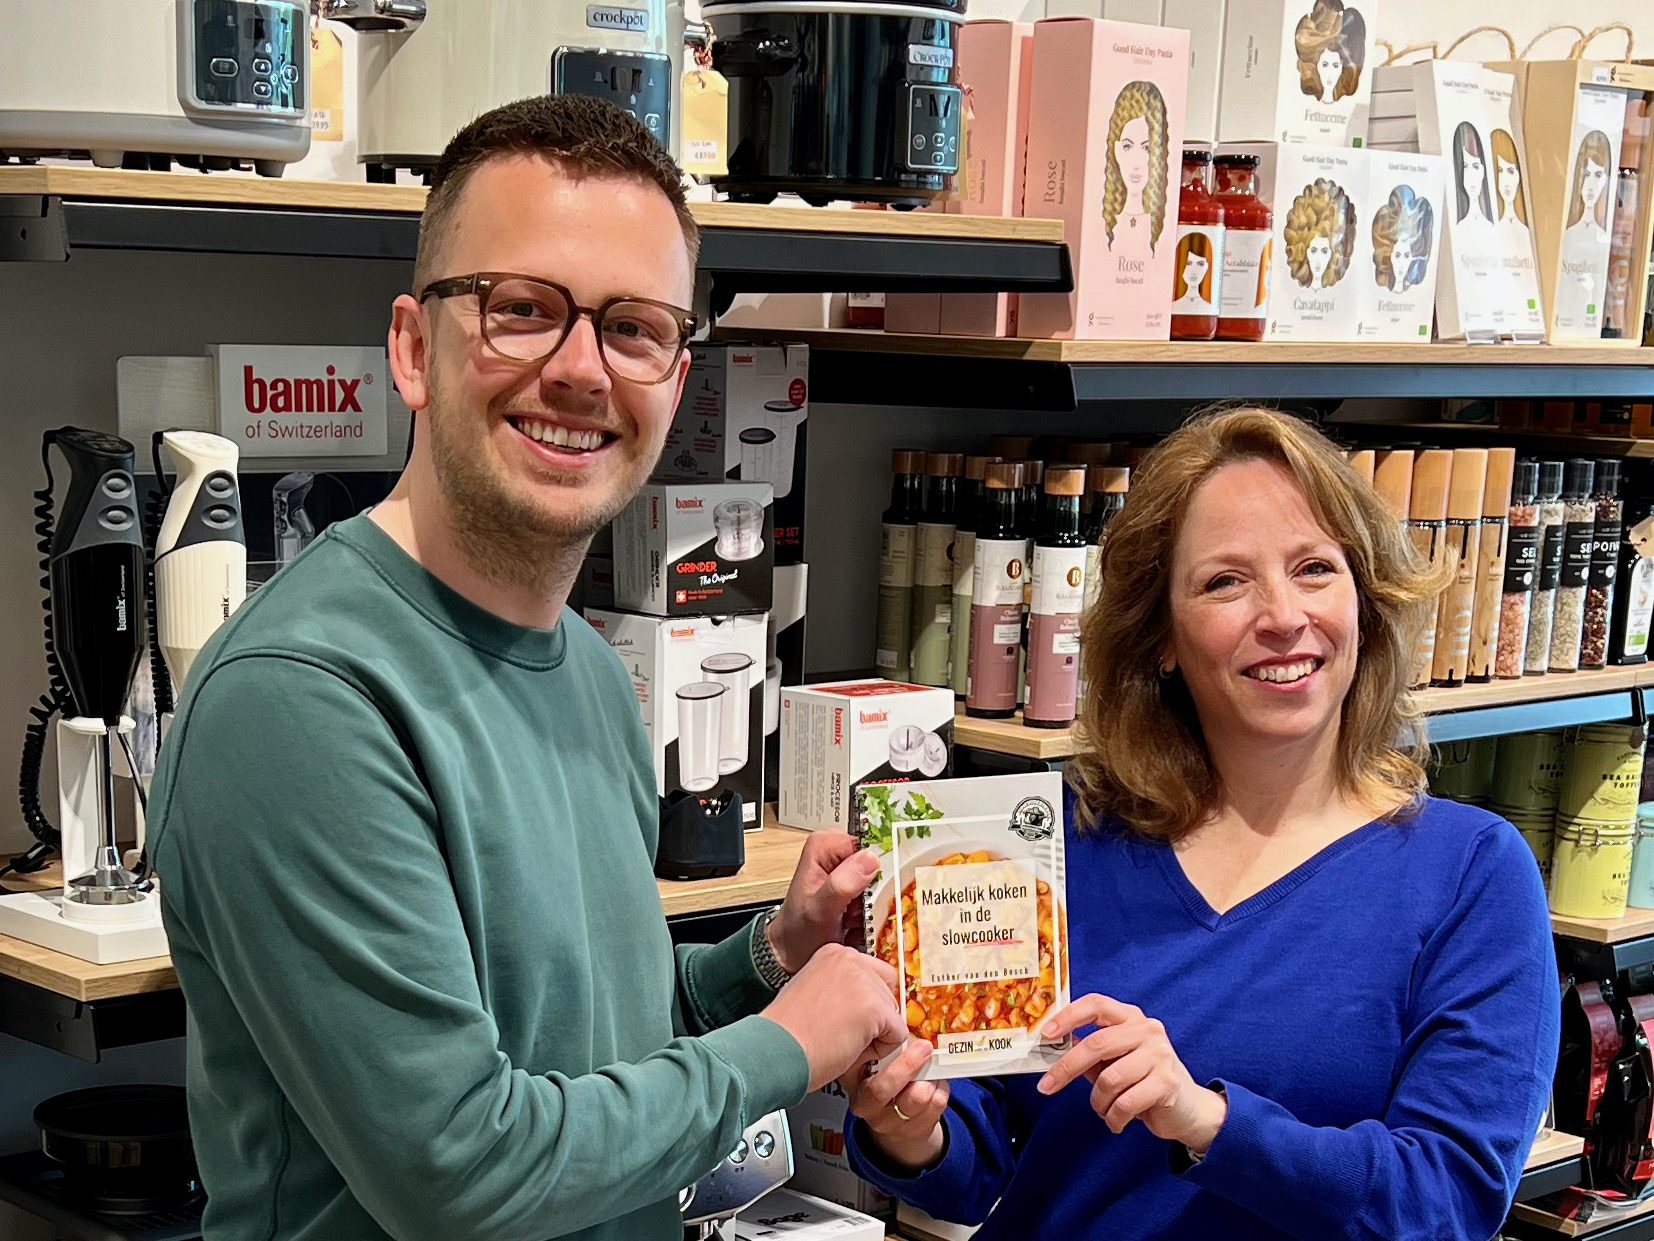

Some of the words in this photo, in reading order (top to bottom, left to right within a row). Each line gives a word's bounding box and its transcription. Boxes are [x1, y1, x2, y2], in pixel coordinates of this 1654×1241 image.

[592, 9, 644, 29] crockpot
[1043, 160, 1057, 202] Rose
[1117, 256, 1145, 273] Rose
[245, 420, 261, 438] of
[268, 420, 364, 439] Switzerland
[675, 496, 704, 509] bamix
[676, 561, 717, 574] GRINDER
[699, 575, 712, 587] The
[712, 569, 738, 585] Original
[859, 708, 888, 724] bamix
[834, 707, 844, 746] bamix
[922, 885, 985, 906] Makkelijk
[988, 883, 1027, 900] koken
[959, 908, 971, 923] in
[976, 905, 992, 922] de
[942, 925, 1015, 946] slowcooker
[931, 972, 960, 982] Esther
[965, 971, 979, 979] van
[984, 969, 999, 978] den
[1003, 966, 1029, 977] Bosch
[988, 1037, 1012, 1050] KOOK
